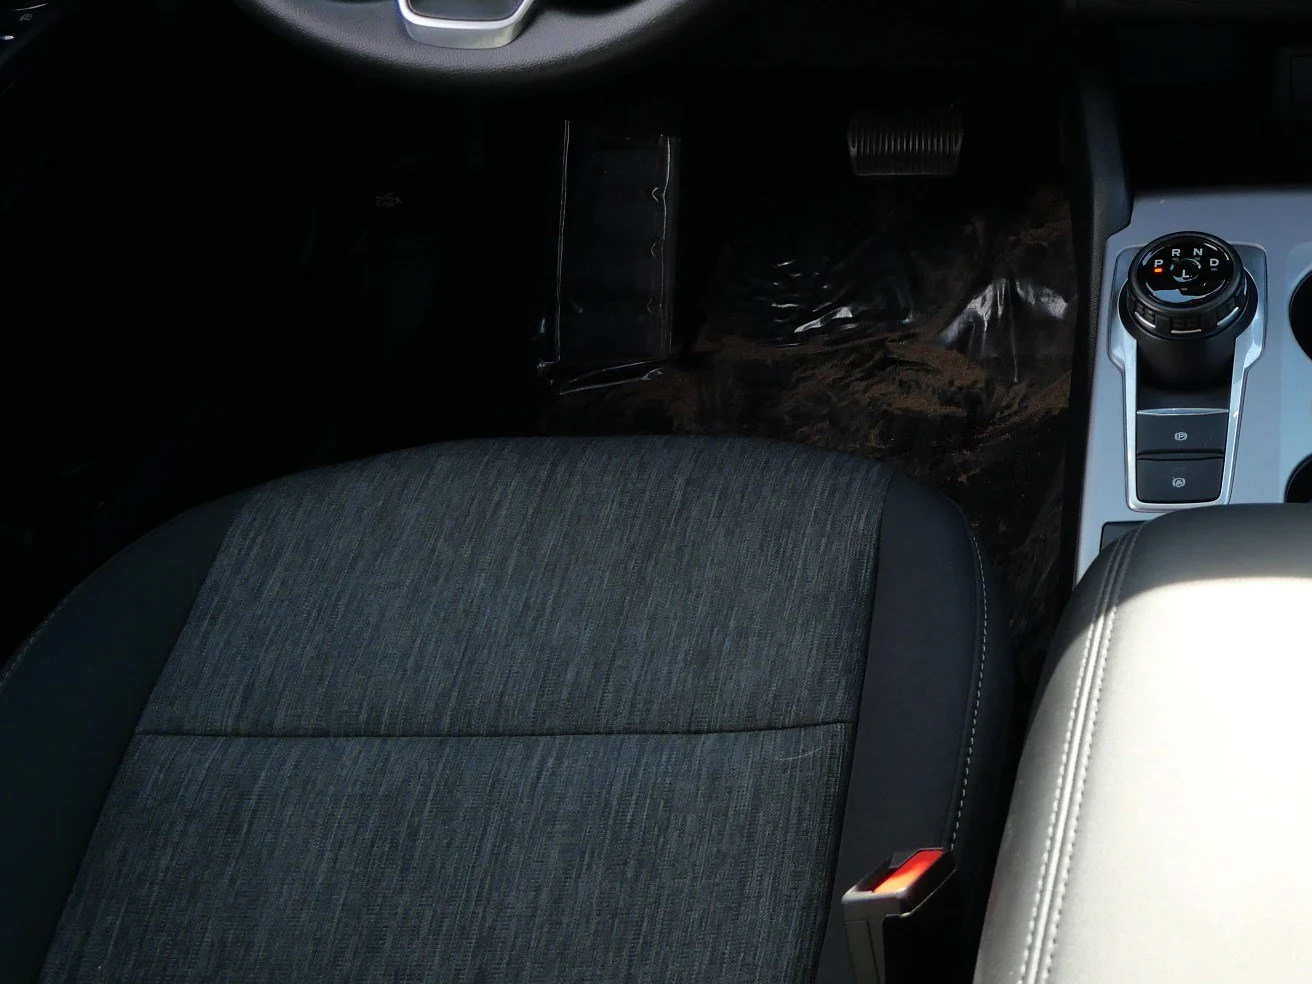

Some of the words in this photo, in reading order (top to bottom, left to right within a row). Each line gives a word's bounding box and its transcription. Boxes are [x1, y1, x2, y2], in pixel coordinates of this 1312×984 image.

[1154, 259, 1164, 268] P
[1171, 248, 1182, 257] R
[1192, 248, 1204, 256] N
[1209, 258, 1220, 267] D
[1182, 269, 1190, 278] L
